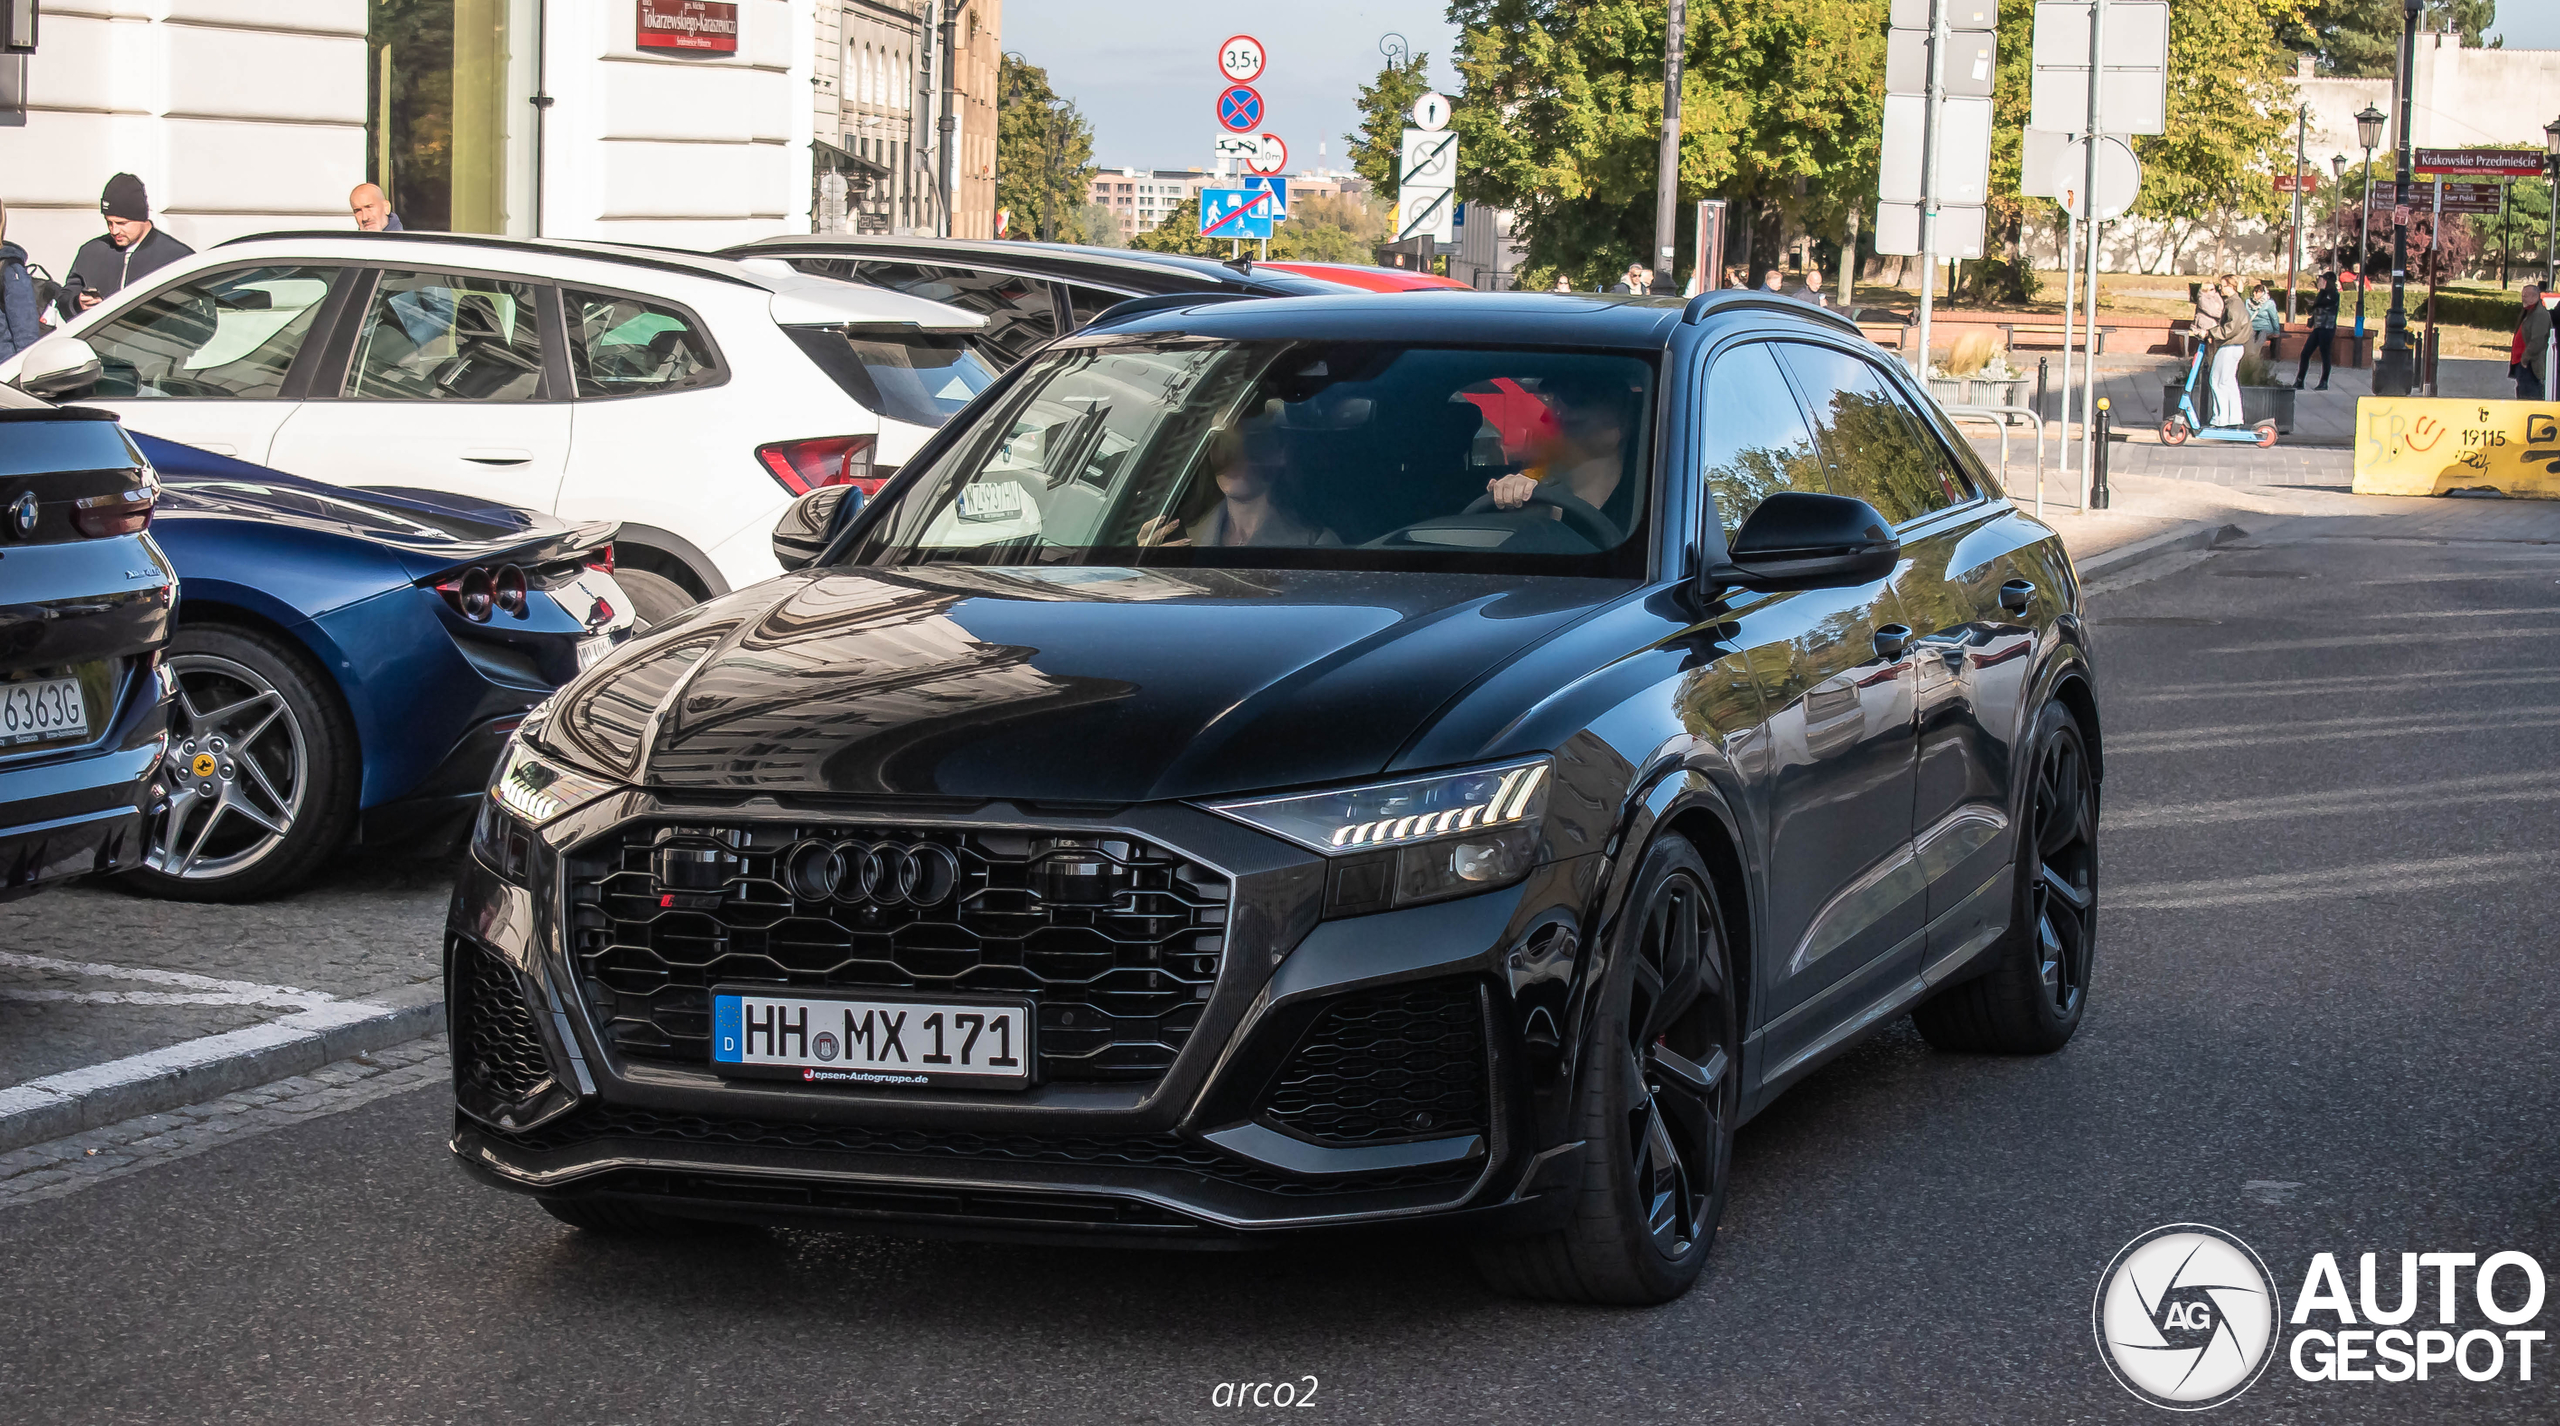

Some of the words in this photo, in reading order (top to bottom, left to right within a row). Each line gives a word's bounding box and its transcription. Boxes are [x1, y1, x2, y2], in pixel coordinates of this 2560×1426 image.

[643, 8, 736, 37] Tokarzewskiego-Karaszewicza
[2421, 154, 2474, 166] Krakowskie
[2476, 154, 2537, 168] Przedmieście
[2462, 429, 2506, 447] 19115
[4, 684, 79, 731] 6363G
[724, 1037, 734, 1051] D
[745, 1004, 809, 1058] HH
[844, 1009, 909, 1062] MX
[922, 1012, 1019, 1067] 171
[804, 1068, 929, 1083] Jepsen-Autogruppe.de
